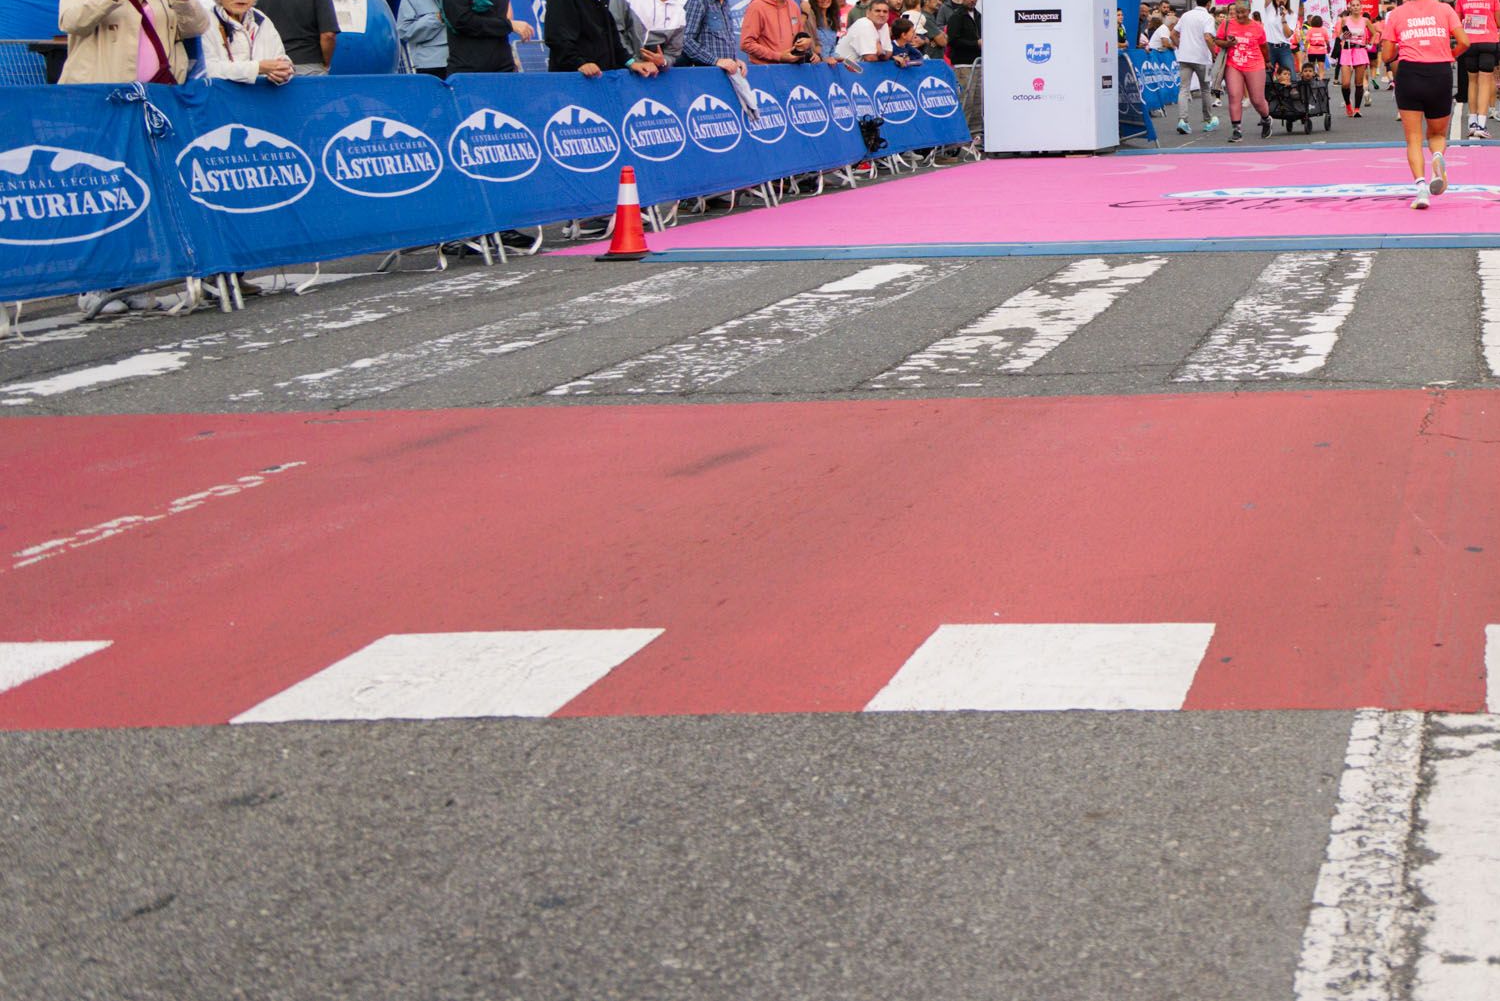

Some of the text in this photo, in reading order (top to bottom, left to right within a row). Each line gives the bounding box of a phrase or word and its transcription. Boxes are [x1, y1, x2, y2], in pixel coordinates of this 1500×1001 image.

[1018, 11, 1060, 22] Neutrogena
[1407, 15, 1436, 28] SOMOS
[791, 105, 828, 125] ASTURIANA
[630, 122, 683, 148] ASTURIANA
[692, 117, 740, 140] ASTURIANA
[348, 144, 388, 154] CENTRAL
[460, 139, 537, 167] ASTURIANA
[552, 131, 617, 158] ASTURIANA
[205, 155, 251, 166] CENTRAL
[335, 150, 437, 181] ASTURIANA
[0, 174, 121, 192] ENTRAL LECHER
[191, 158, 308, 193] ASTURIANA
[0, 186, 137, 222] STURIANA
